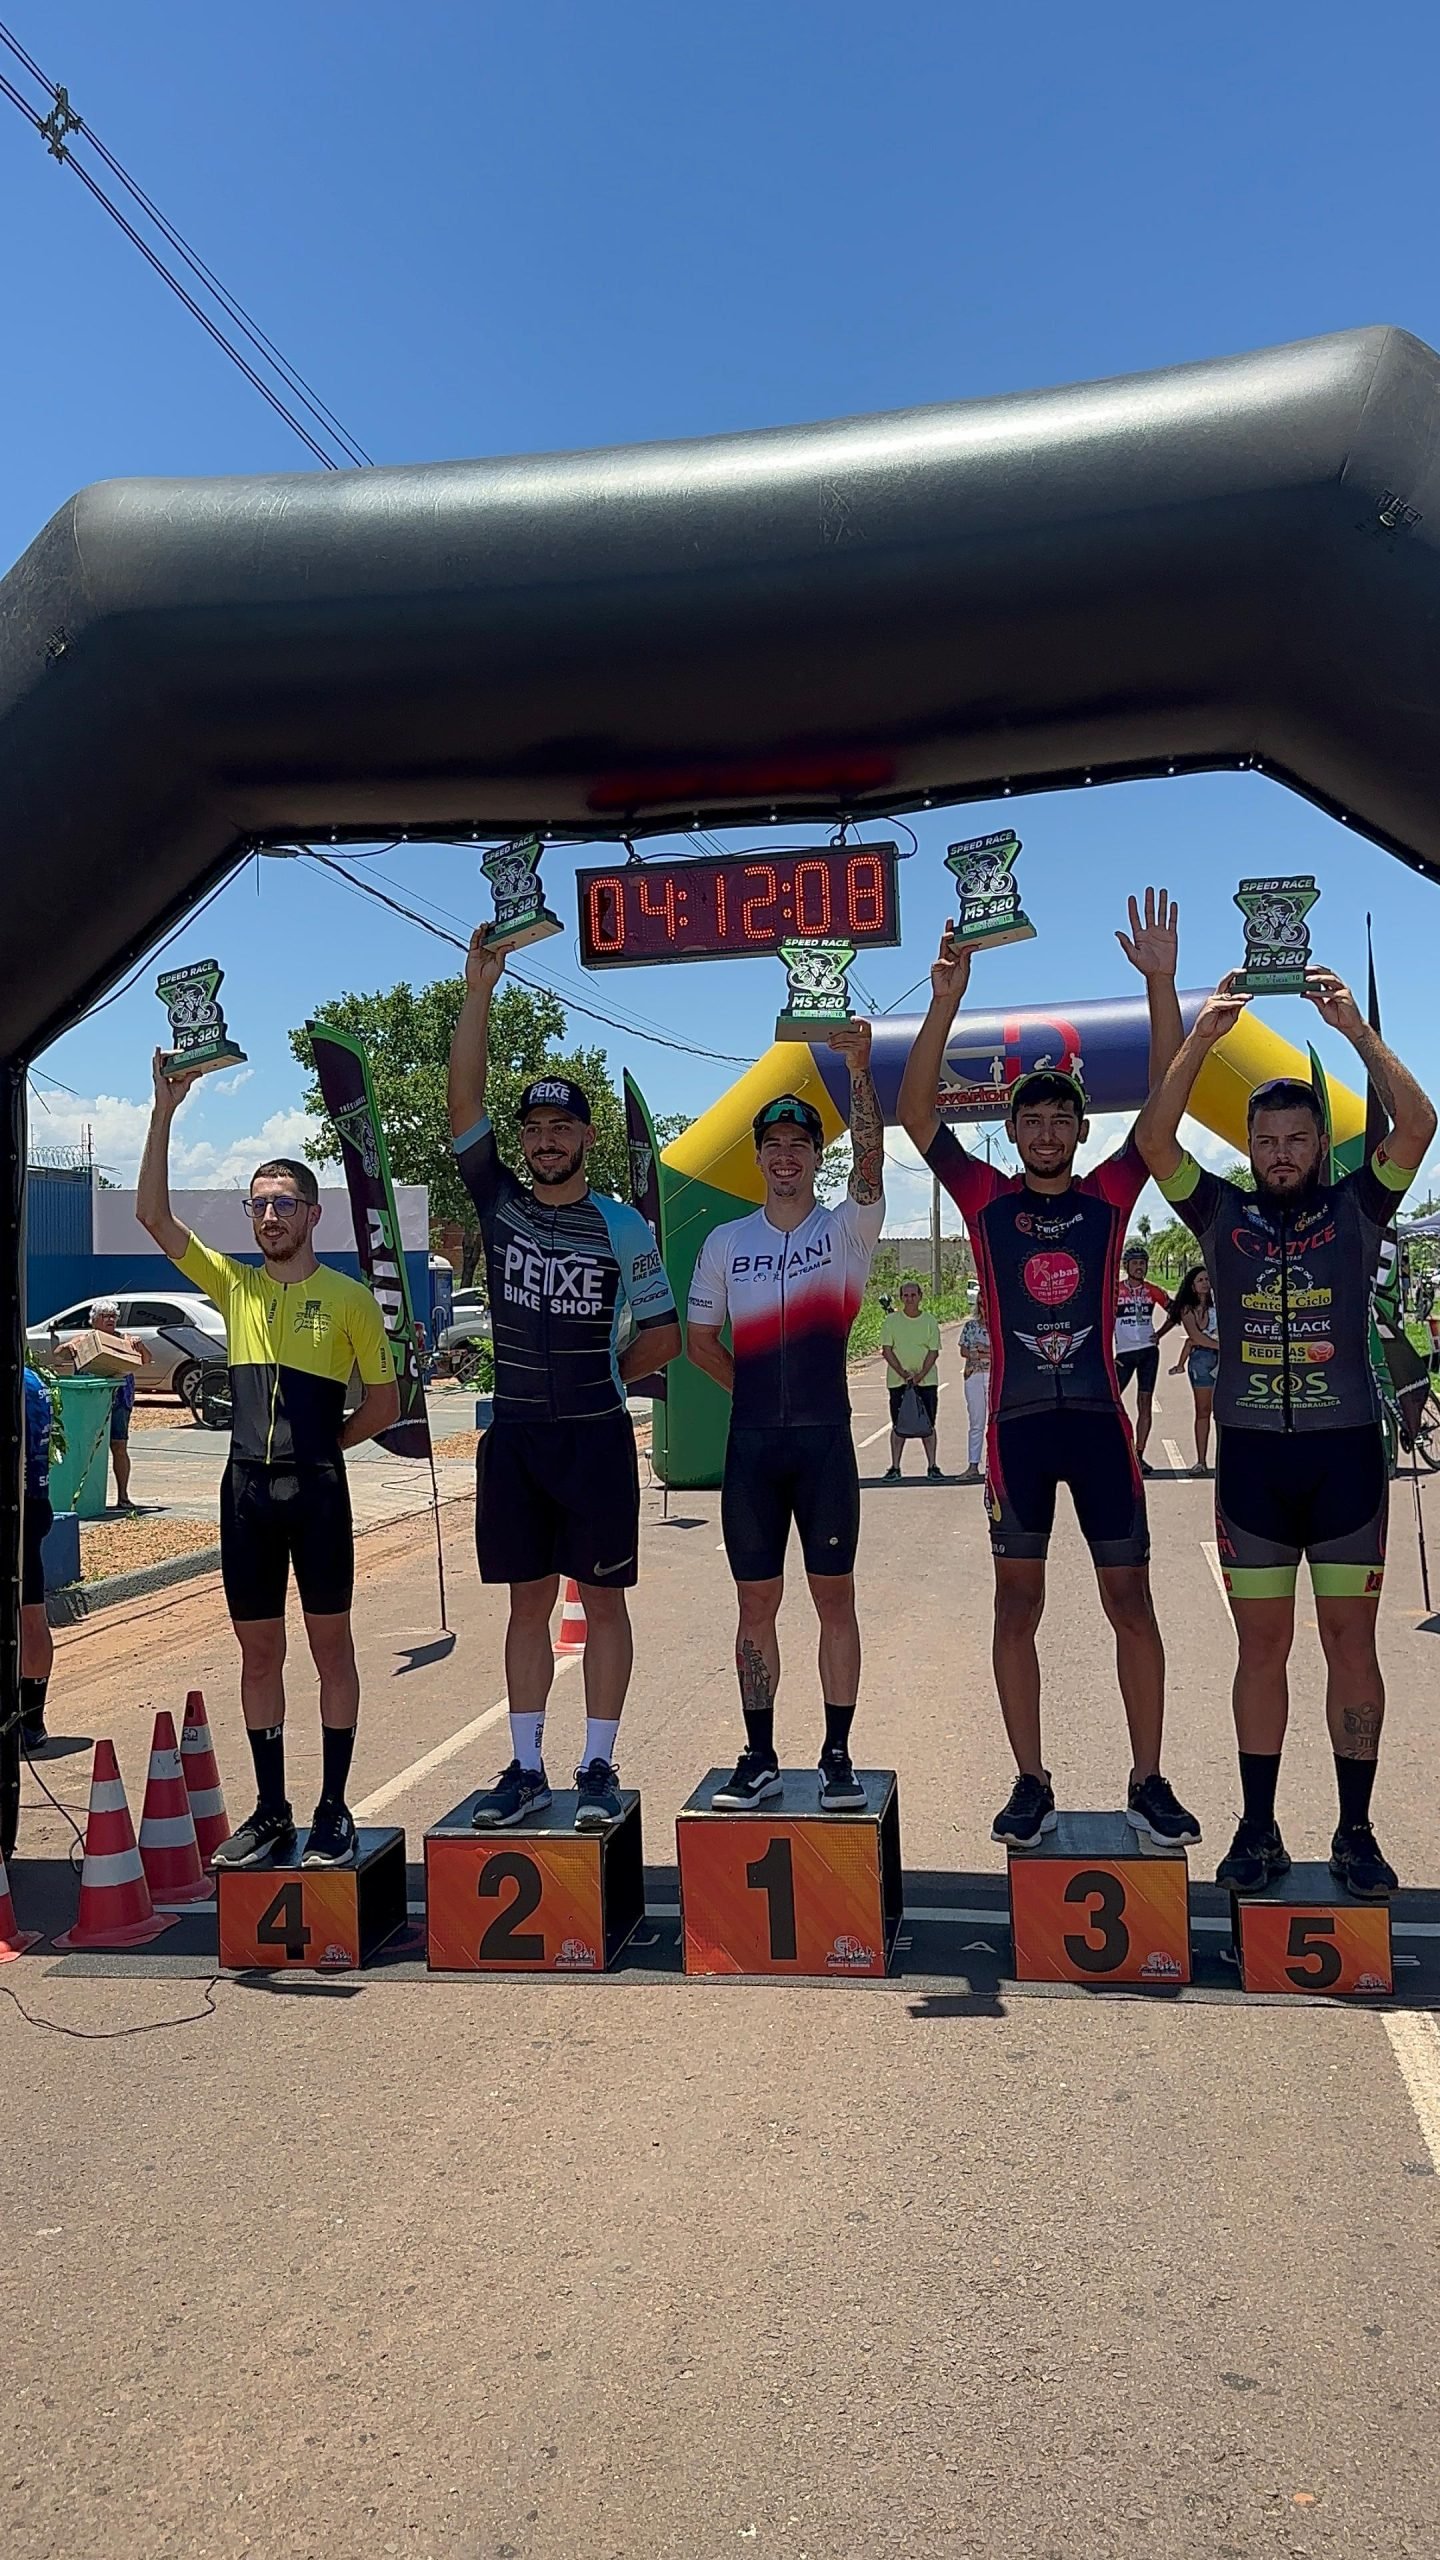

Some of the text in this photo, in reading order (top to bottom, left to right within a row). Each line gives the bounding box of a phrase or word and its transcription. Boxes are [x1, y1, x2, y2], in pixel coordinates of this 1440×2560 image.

[485, 834, 534, 862] SPEED RACE
[950, 831, 1013, 856] SPEED RACE
[1242, 879, 1313, 892] SPEED RACE
[498, 895, 539, 921] MS-320
[590, 856, 883, 951] 04:12:08
[964, 896, 1015, 921] MS-320
[785, 938, 850, 947] SPEED RACE
[1248, 951, 1306, 967] MS-320
[160, 961, 214, 985] SPEED RACE
[792, 996, 845, 1009] MS-320
[177, 1025, 220, 1050] MS-320
[529, 1082, 571, 1101] PEIXE
[632, 1251, 661, 1274] PEIXE
[731, 1233, 832, 1275] BRIANI
[504, 1243, 604, 1299] PEIXE
[632, 1271, 648, 1283] BIKE
[798, 1261, 820, 1275] TEAM
[1041, 1279, 1066, 1288] BKE
[503, 1283, 603, 1316] BIKE SHOP
[632, 1288, 669, 1307] OGGI
[1243, 1294, 1330, 1311] Cente Ciclo
[1036, 1321, 1071, 1331] COYOTE
[1244, 1322, 1280, 1335] CAFÉ
[478, 1851, 545, 1961] 2
[746, 1838, 798, 1960] 1
[257, 1882, 312, 1960] 4
[1064, 1869, 1130, 1973] 3
[1285, 1916, 1342, 1989] 5
